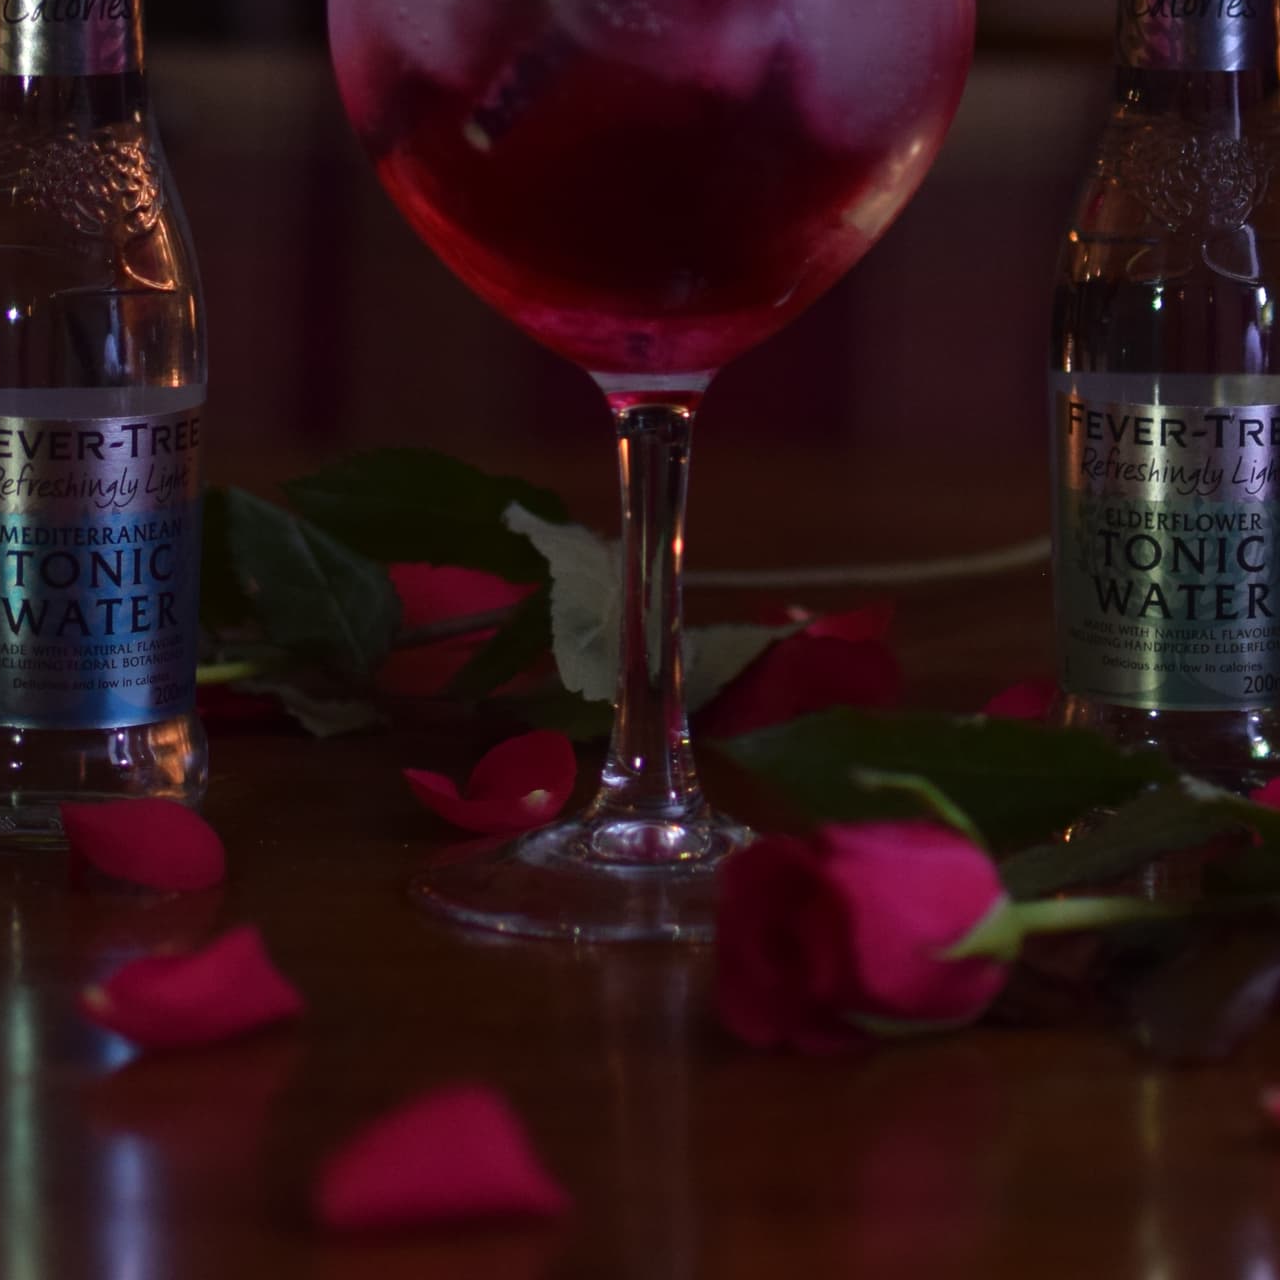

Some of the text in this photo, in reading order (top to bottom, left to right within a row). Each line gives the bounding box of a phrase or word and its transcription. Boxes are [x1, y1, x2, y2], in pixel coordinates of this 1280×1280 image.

[145, 465, 190, 504] Light
[1080, 447, 1225, 496] Refreshingly
[1105, 508, 1263, 532] ELDERFLOWER
[6, 543, 176, 589] TONIC
[1096, 529, 1267, 574] TONIC
[2, 591, 179, 637] WATER
[1093, 576, 1276, 620] WATER
[71, 643, 133, 658] NATURAL
[1117, 624, 1151, 638] WITH
[1154, 627, 1218, 641] NATURAL
[1124, 638, 1210, 655] HANDPICKED
[1179, 660, 1203, 673] low
[1219, 660, 1264, 674] calories
